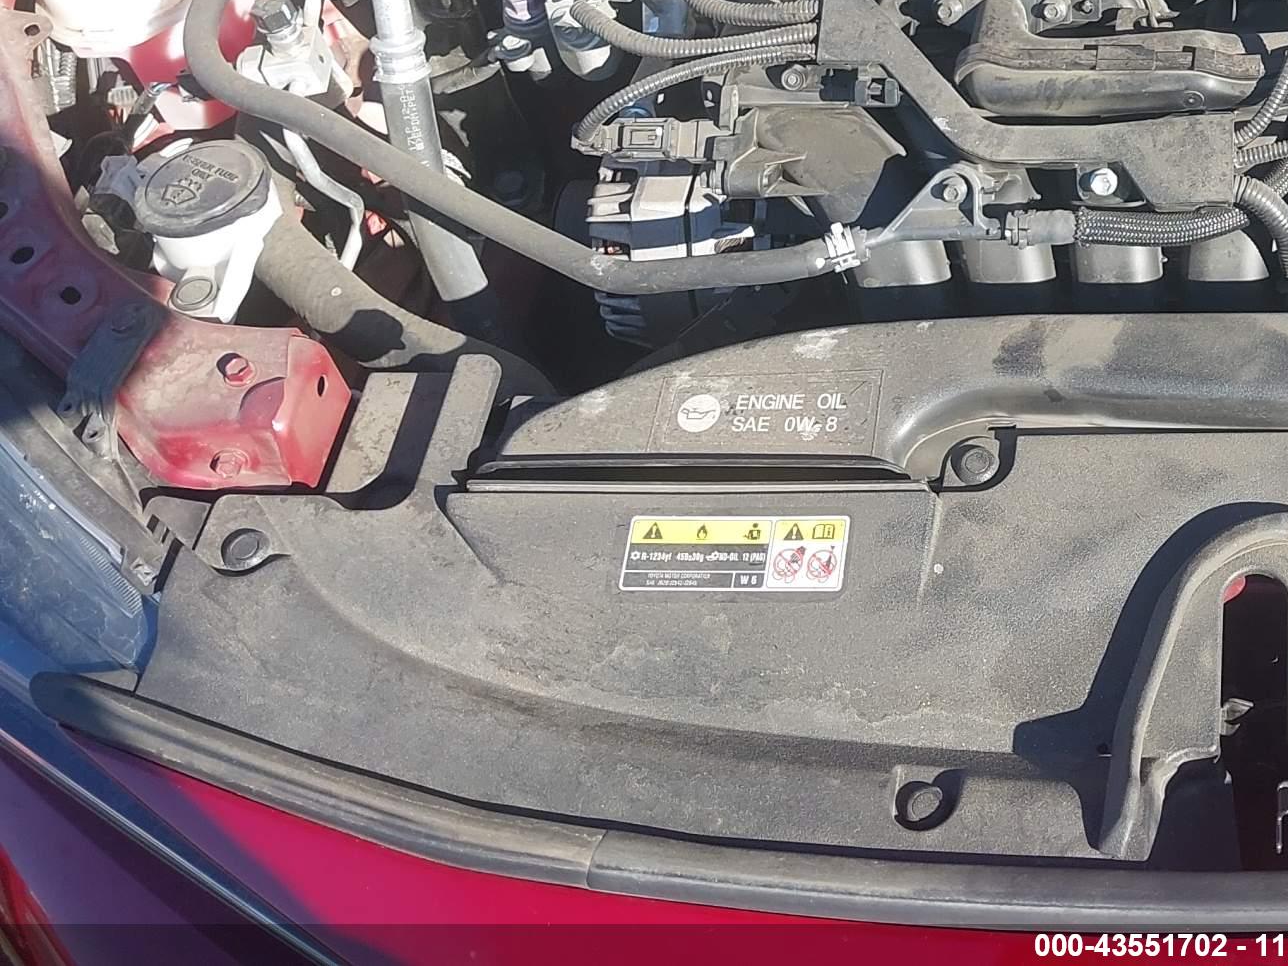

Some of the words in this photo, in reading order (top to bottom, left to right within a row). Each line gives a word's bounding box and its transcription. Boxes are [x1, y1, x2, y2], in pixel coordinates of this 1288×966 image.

[736, 394, 805, 410] ENGINE
[817, 393, 847, 410] OIL
[732, 417, 770, 432] SAE
